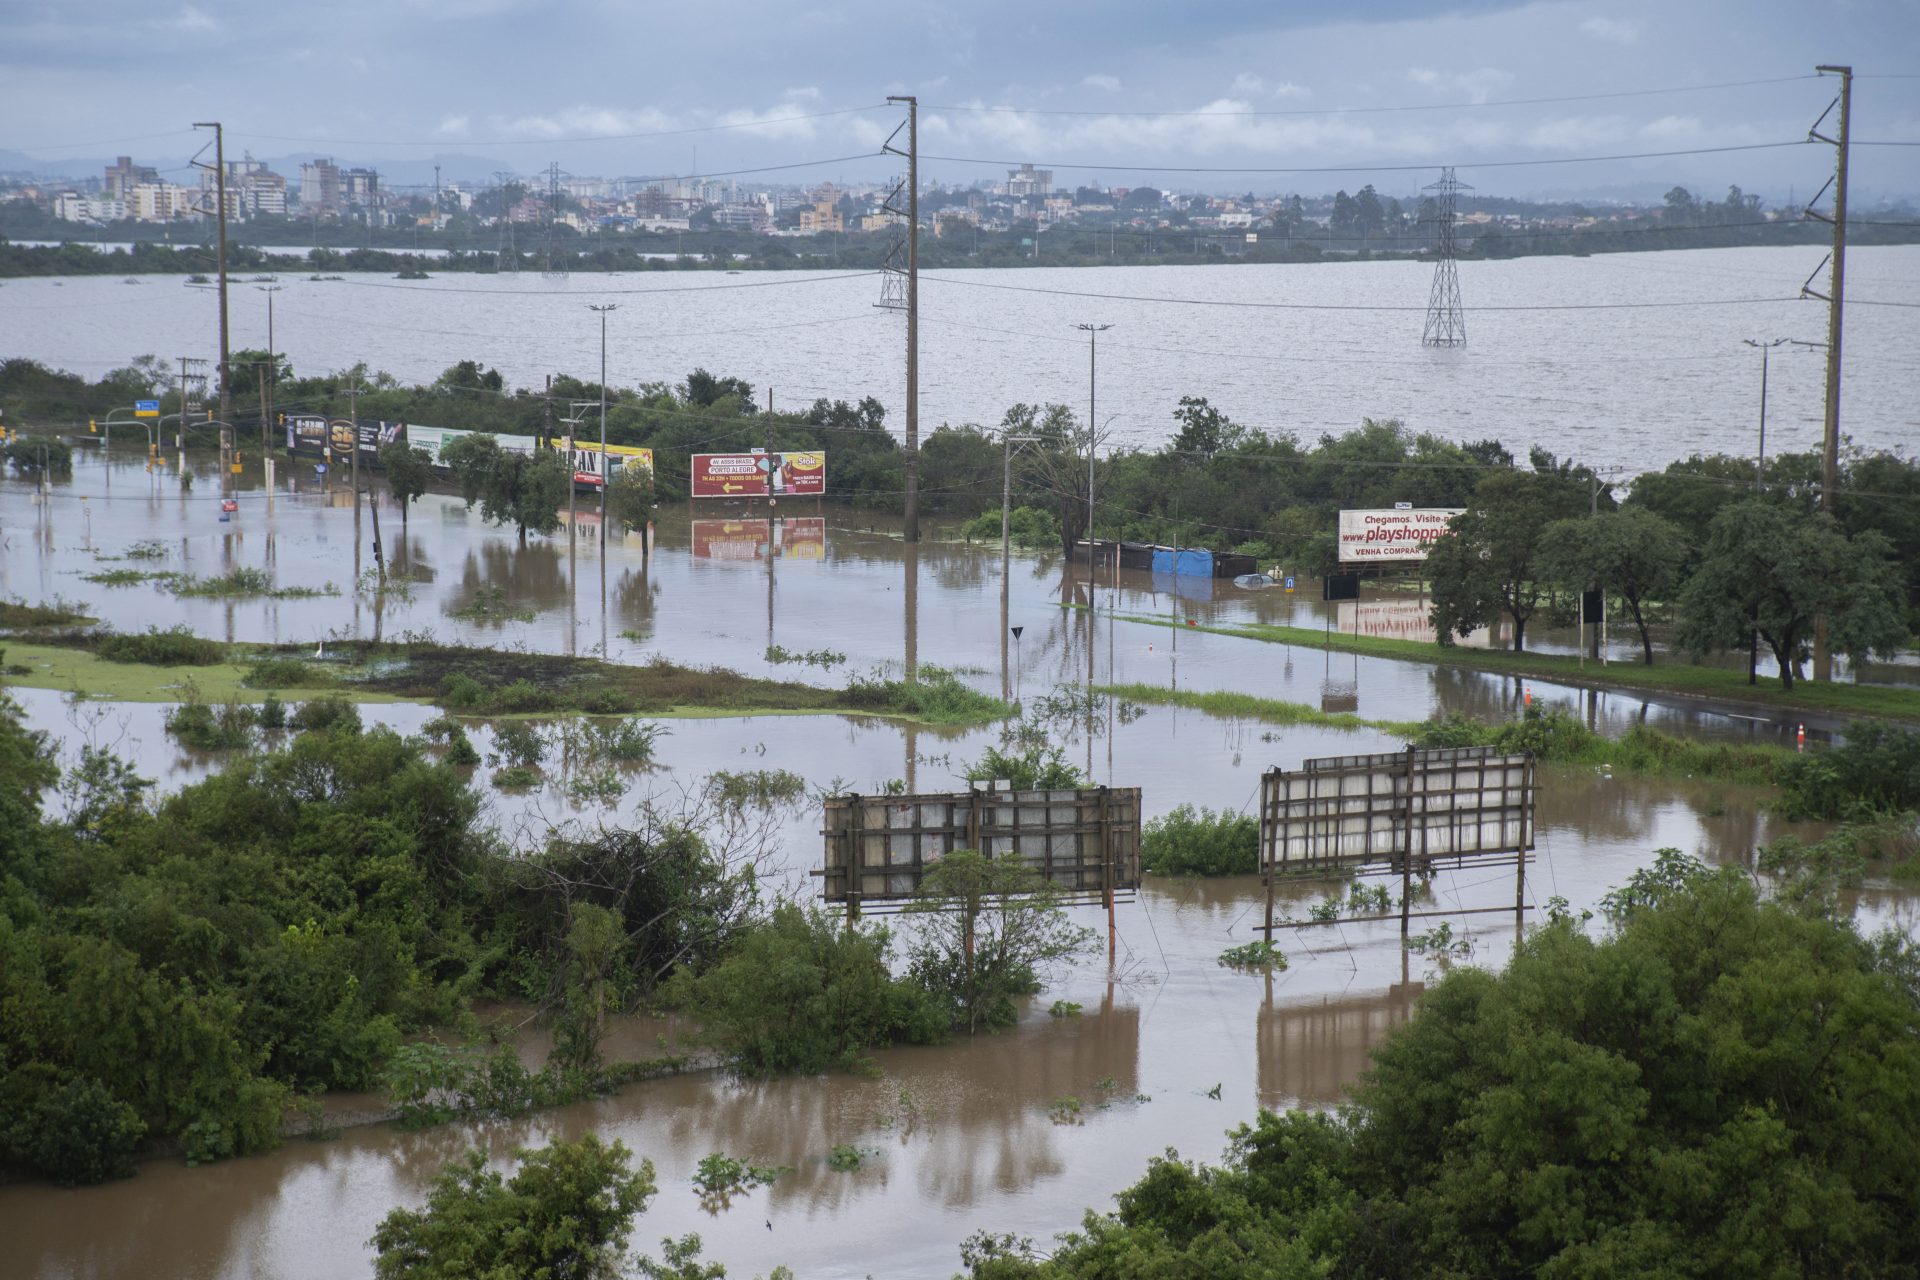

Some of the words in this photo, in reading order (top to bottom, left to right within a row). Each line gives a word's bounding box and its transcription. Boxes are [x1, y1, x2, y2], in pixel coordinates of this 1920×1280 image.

[798, 457, 816, 465] Stok
[1364, 515, 1412, 525] Chegamos.
[1415, 514, 1451, 523] Visite-n
[1355, 548, 1382, 556] VENHA
[1383, 547, 1420, 555] COMPRAR
